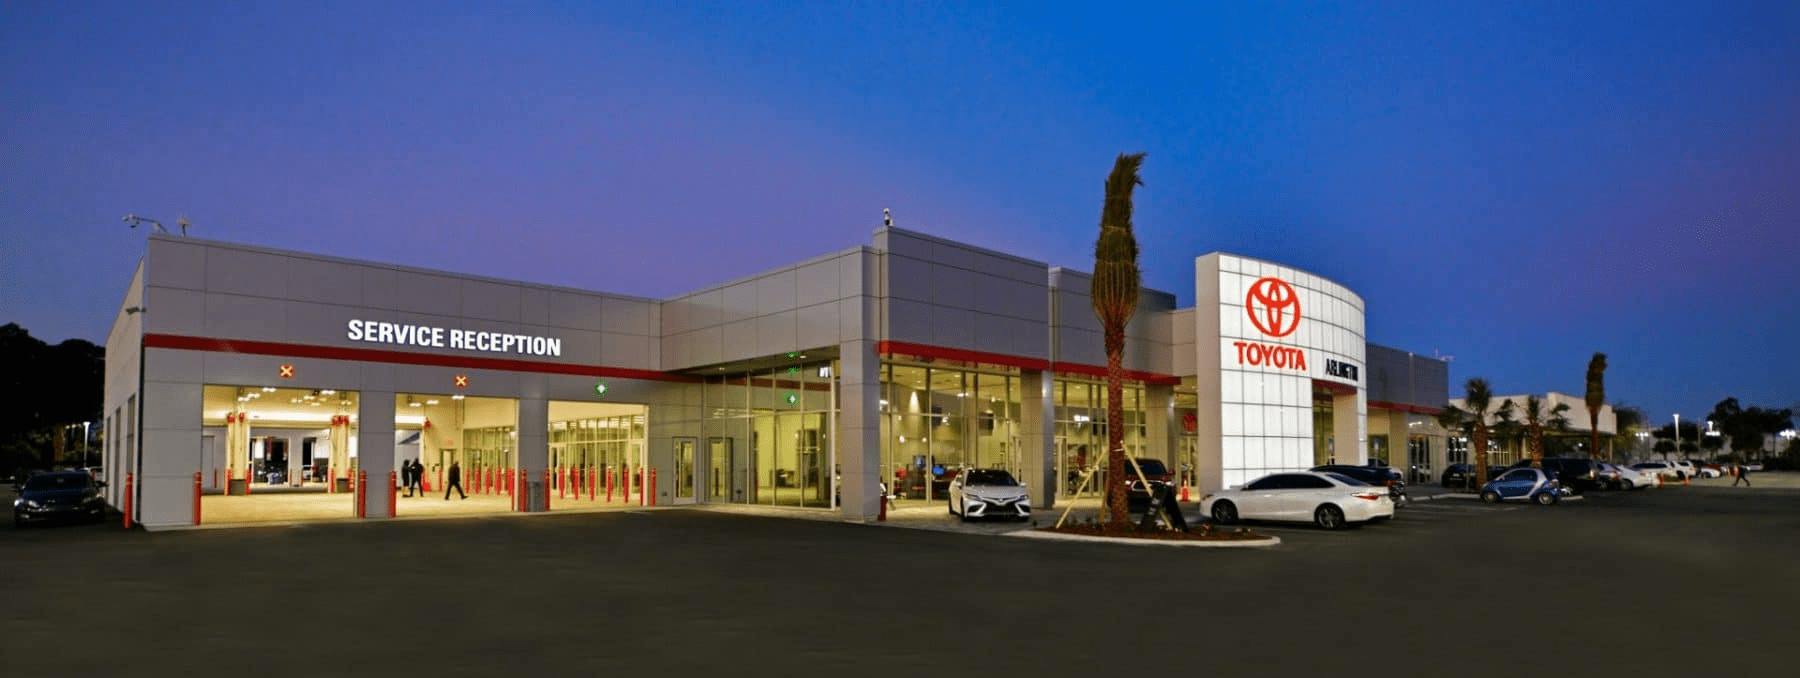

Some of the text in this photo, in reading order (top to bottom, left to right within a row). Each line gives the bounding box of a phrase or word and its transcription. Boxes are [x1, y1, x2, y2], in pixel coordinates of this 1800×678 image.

[348, 319, 561, 356] SERVICE RECEPTION
[1233, 341, 1306, 371] TOYOTA
